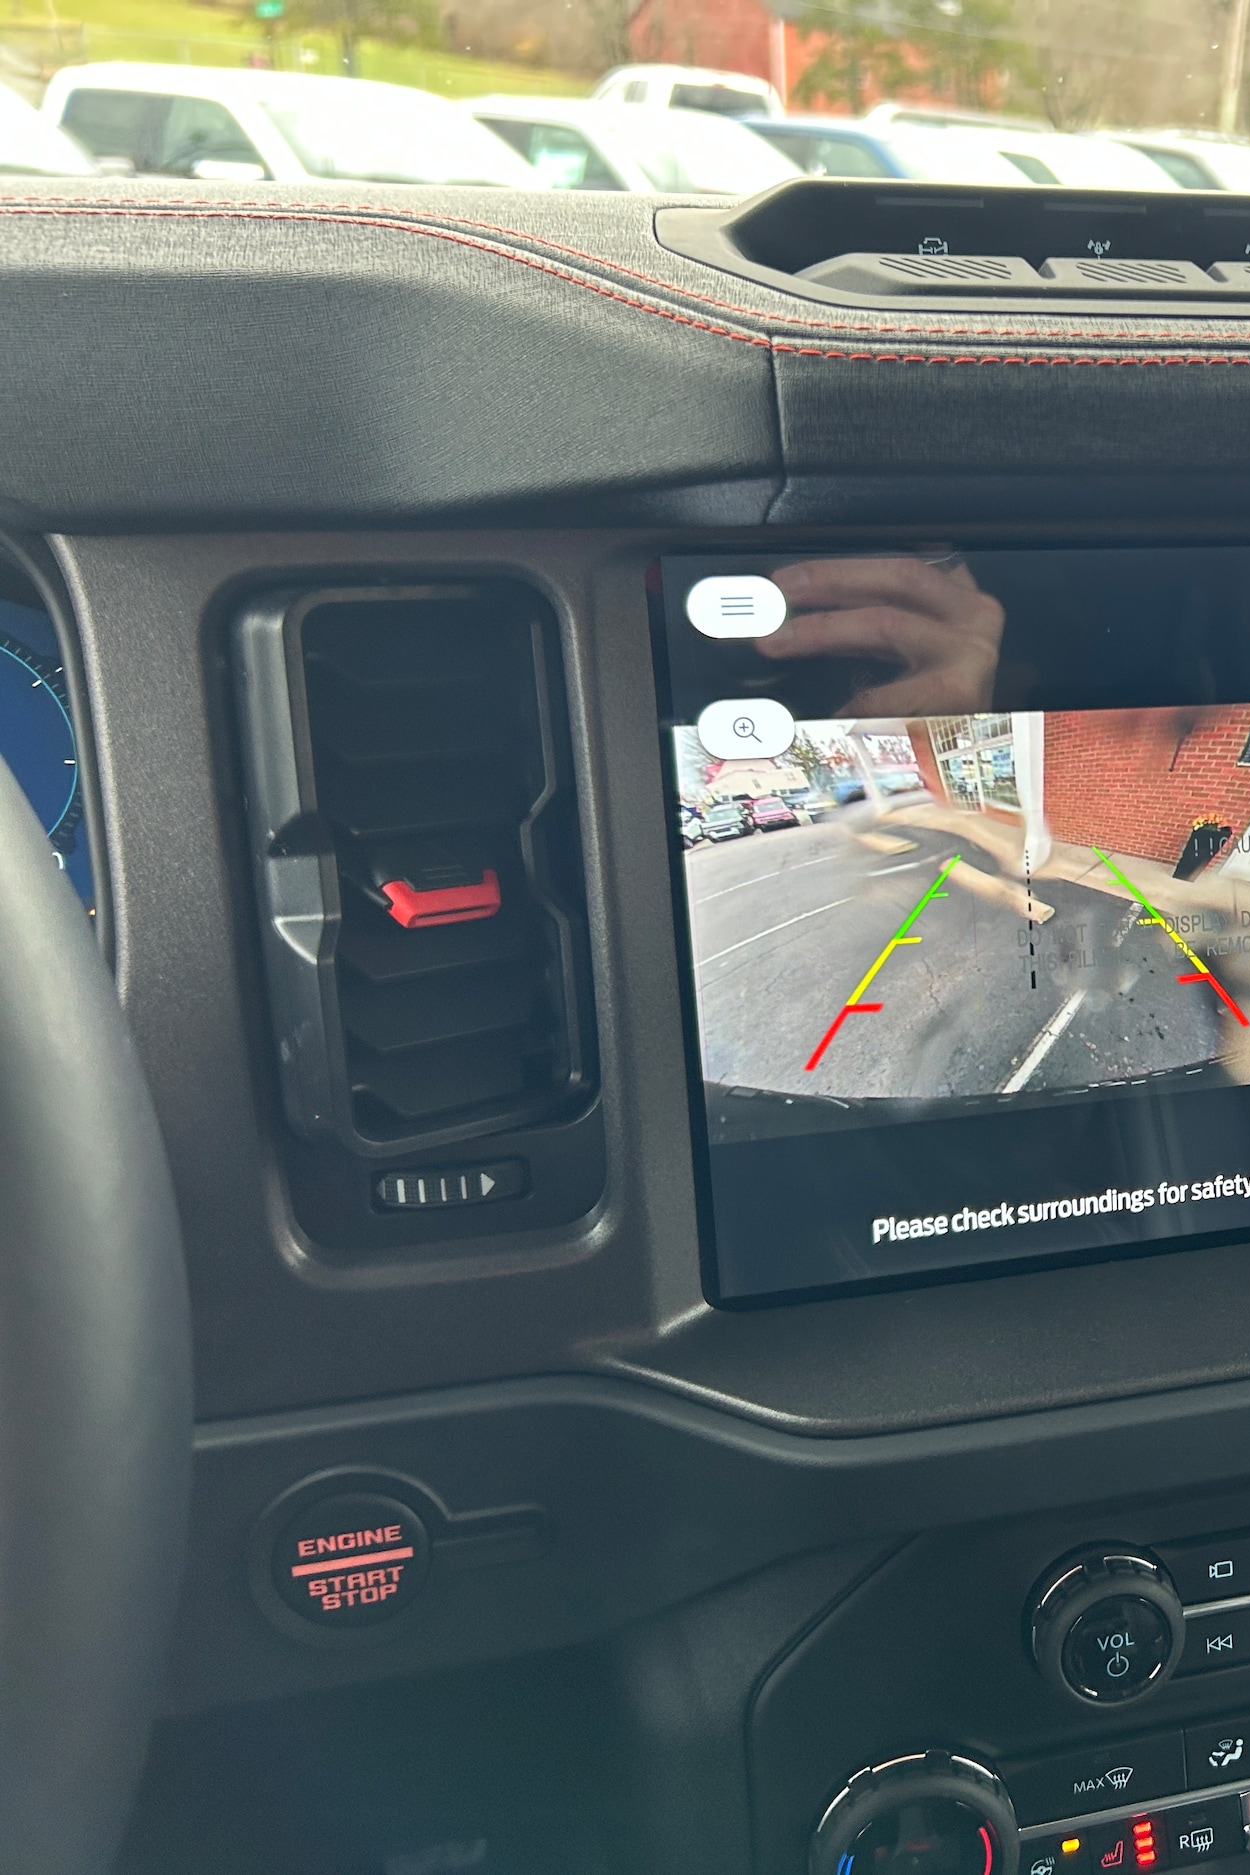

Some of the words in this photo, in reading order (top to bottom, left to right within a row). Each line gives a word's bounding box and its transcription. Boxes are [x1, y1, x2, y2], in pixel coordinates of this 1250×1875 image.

[1164, 910, 1229, 934] DISPLAY
[872, 1217, 949, 1244] Please
[950, 1202, 1016, 1233] check
[1017, 1187, 1154, 1225] surroundings
[1157, 1181, 1189, 1206] for
[298, 1525, 402, 1557] ENGINE
[308, 1565, 404, 1597] START
[321, 1583, 398, 1611] STOP
[1096, 1632, 1135, 1652] VOL
[1073, 1776, 1105, 1795] MAX
